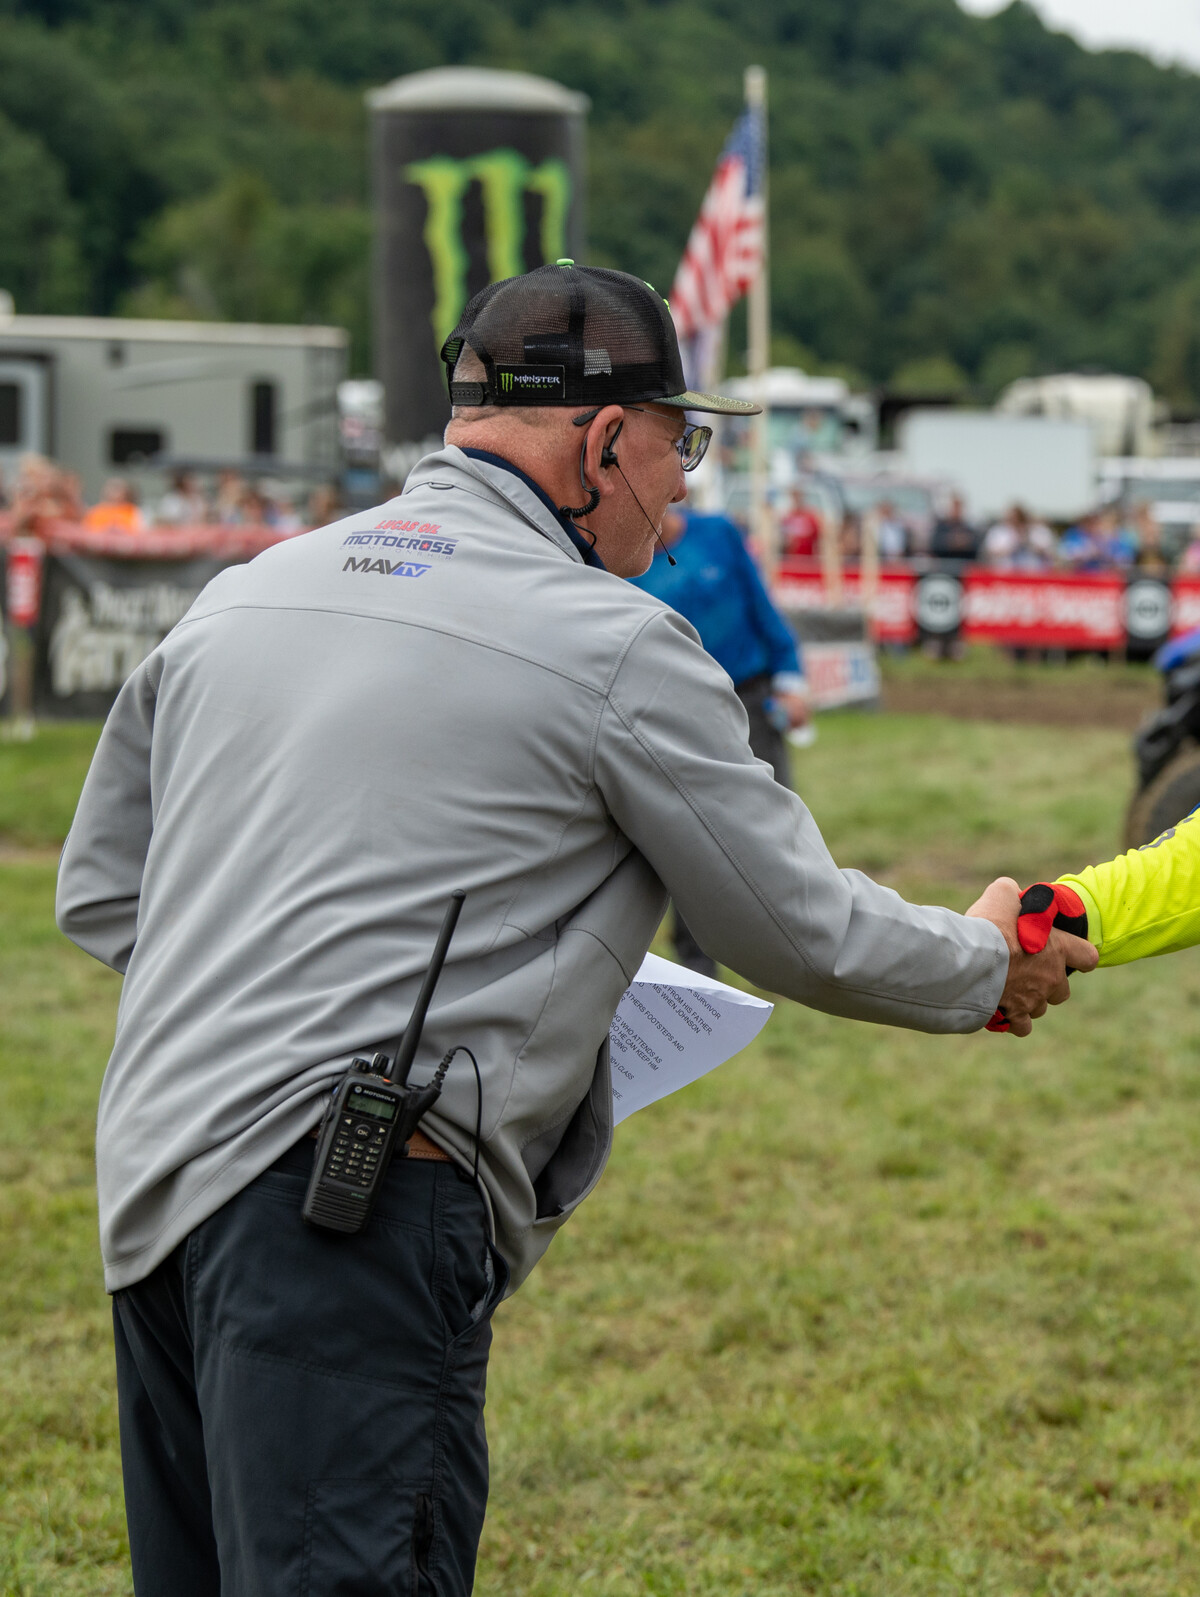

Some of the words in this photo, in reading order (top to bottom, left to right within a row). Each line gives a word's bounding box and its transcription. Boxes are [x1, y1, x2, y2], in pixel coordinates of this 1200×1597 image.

[514, 374, 560, 384] MONSTER
[374, 520, 419, 532] LUCAS
[418, 523, 442, 535] OIL
[343, 535, 456, 556] MOTOCROSS
[667, 986, 684, 1005] FROM
[682, 1002, 693, 1014] HIS
[693, 991, 721, 1020] SURVIVOR
[624, 990, 647, 1013] ATHERS
[644, 1010, 675, 1042] FOOTSTEPS
[671, 1040, 685, 1053] AND
[661, 991, 678, 1010] WHEN
[675, 1008, 701, 1034] JOHNSON
[610, 1034, 628, 1053] GOING
[618, 1030, 628, 1041] HE
[625, 1038, 638, 1051] CAN
[635, 1048, 651, 1062] KEEP
[647, 1061, 659, 1072] HIM
[620, 1020, 634, 1036] WHO
[632, 1034, 656, 1058] ATTENDS
[653, 1055, 663, 1064] AS
[617, 1064, 635, 1081] CLASS
[363, 1089, 396, 1103] MOTOROLA
[357, 1129, 369, 1137] OK
